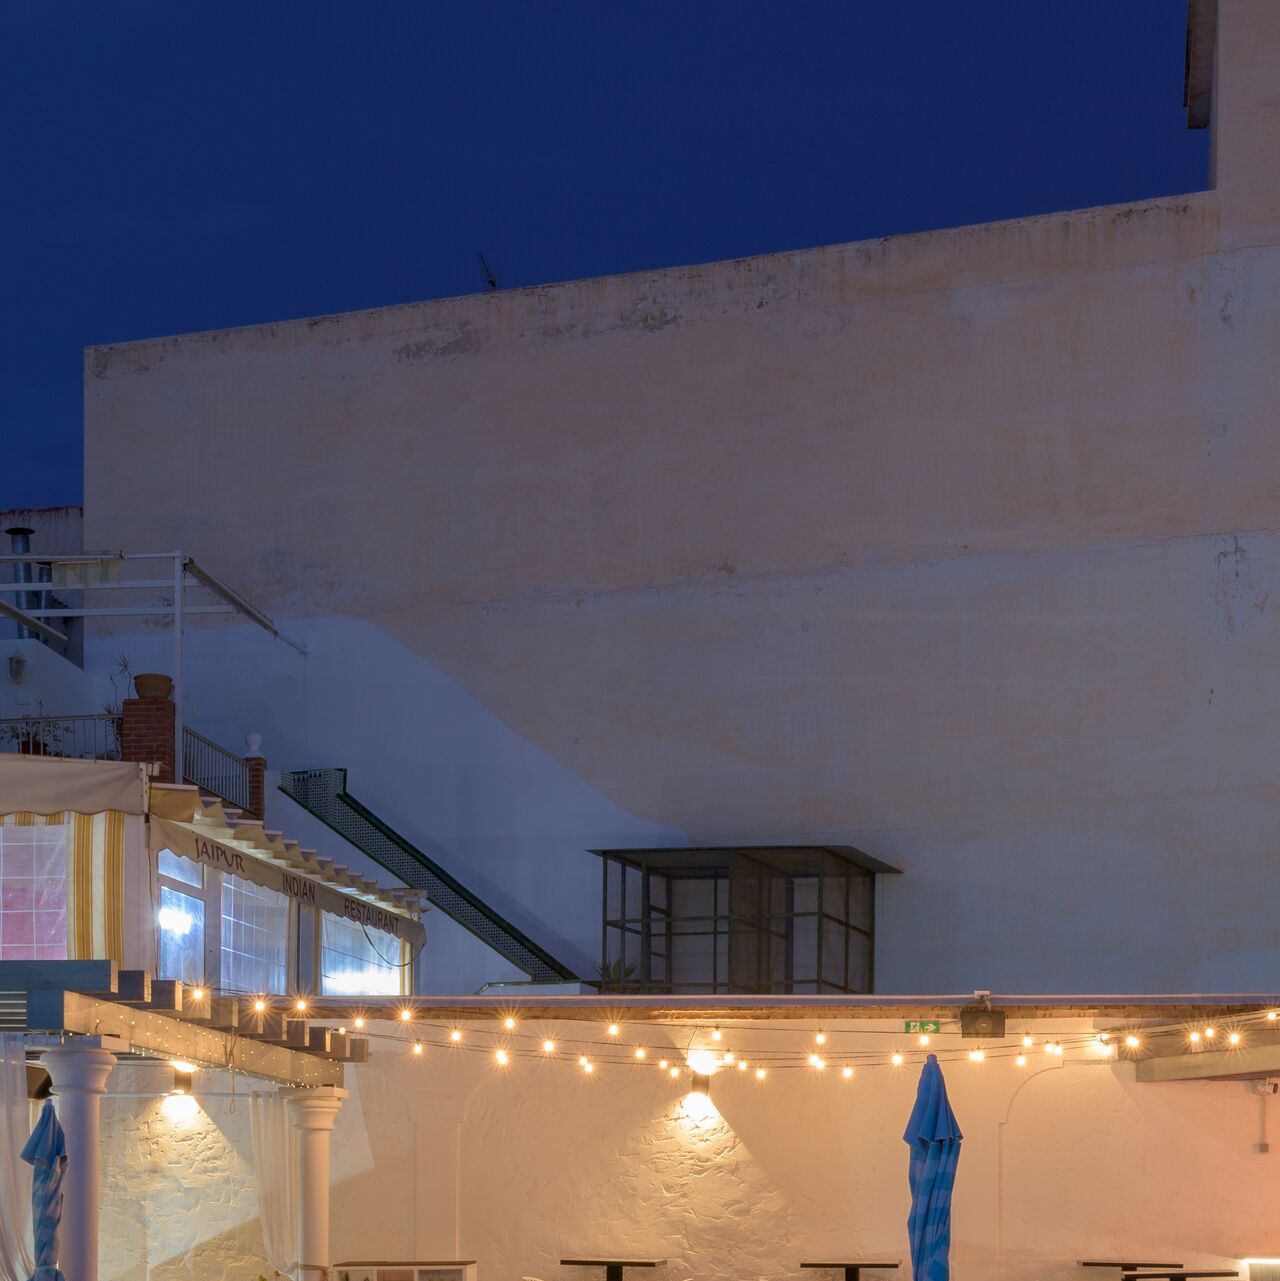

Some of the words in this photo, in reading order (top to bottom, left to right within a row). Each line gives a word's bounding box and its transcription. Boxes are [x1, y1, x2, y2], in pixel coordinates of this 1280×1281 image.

[195, 839, 245, 873] JAIPUR
[282, 873, 316, 902] INDIAN
[344, 898, 400, 933] RESTAURANT
